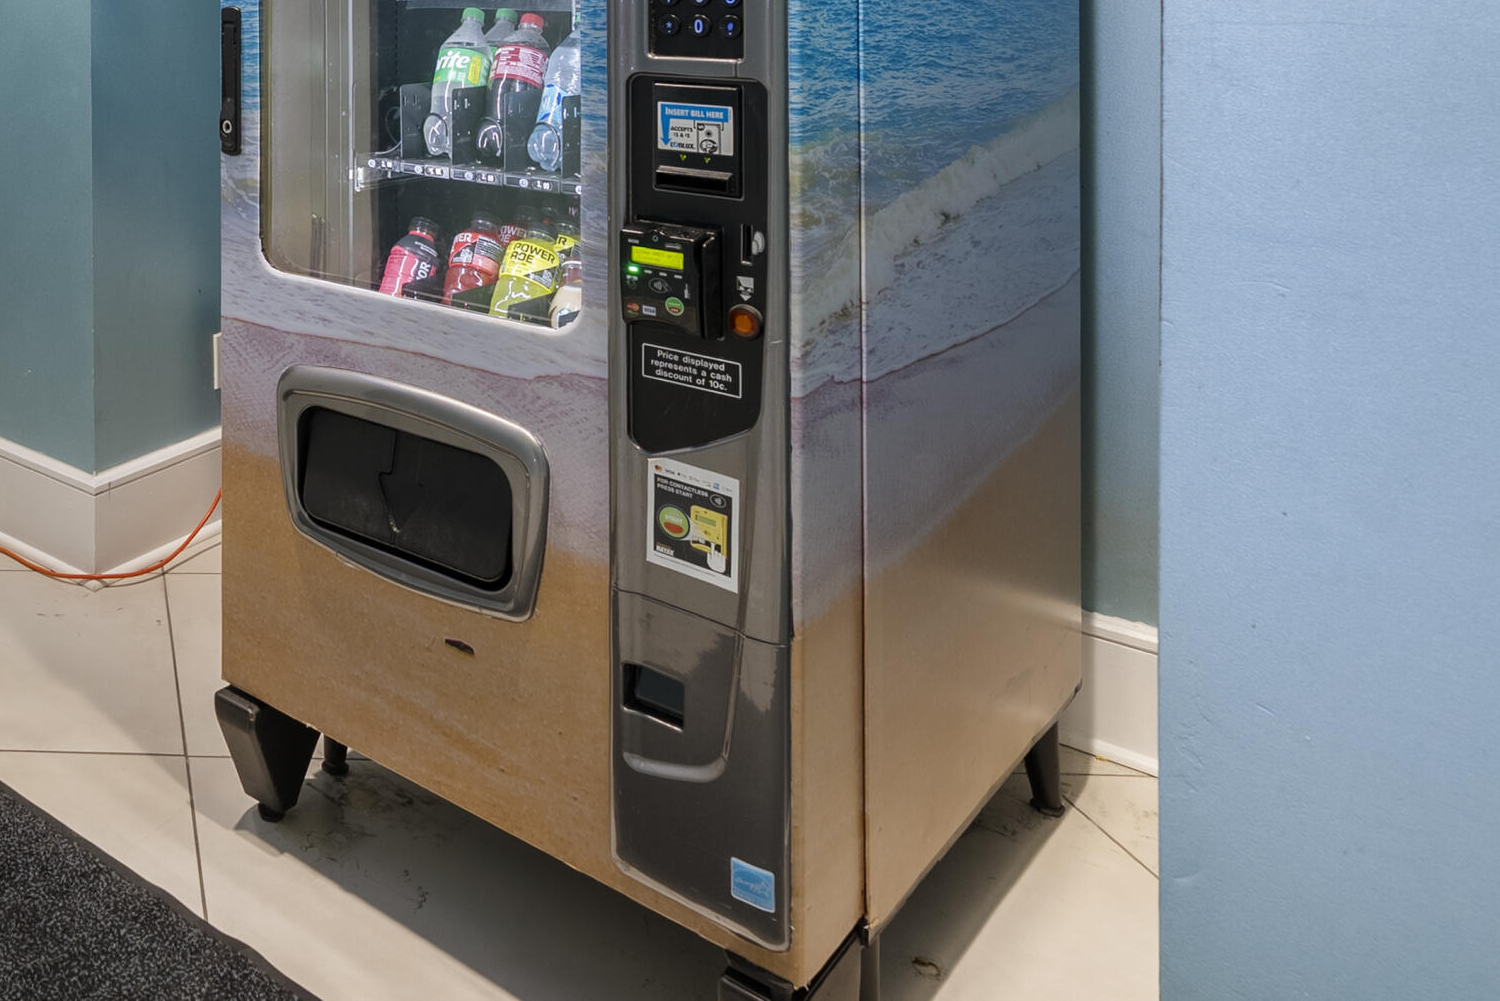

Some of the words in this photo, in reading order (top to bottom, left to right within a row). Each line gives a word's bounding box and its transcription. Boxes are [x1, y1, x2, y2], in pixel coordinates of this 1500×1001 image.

[694, 19, 703, 34] 0
[665, 106, 689, 117] INSERT
[690, 108, 705, 118] BILL
[706, 109, 724, 119] HERE
[513, 242, 555, 264] POWER
[657, 349, 679, 362] Price
[682, 356, 725, 372] displayed
[650, 358, 698, 376] represents
[710, 371, 732, 383] cash
[655, 368, 692, 384] discount
[696, 378, 705, 386] of
[669, 480, 709, 498] CONTACTLESS
